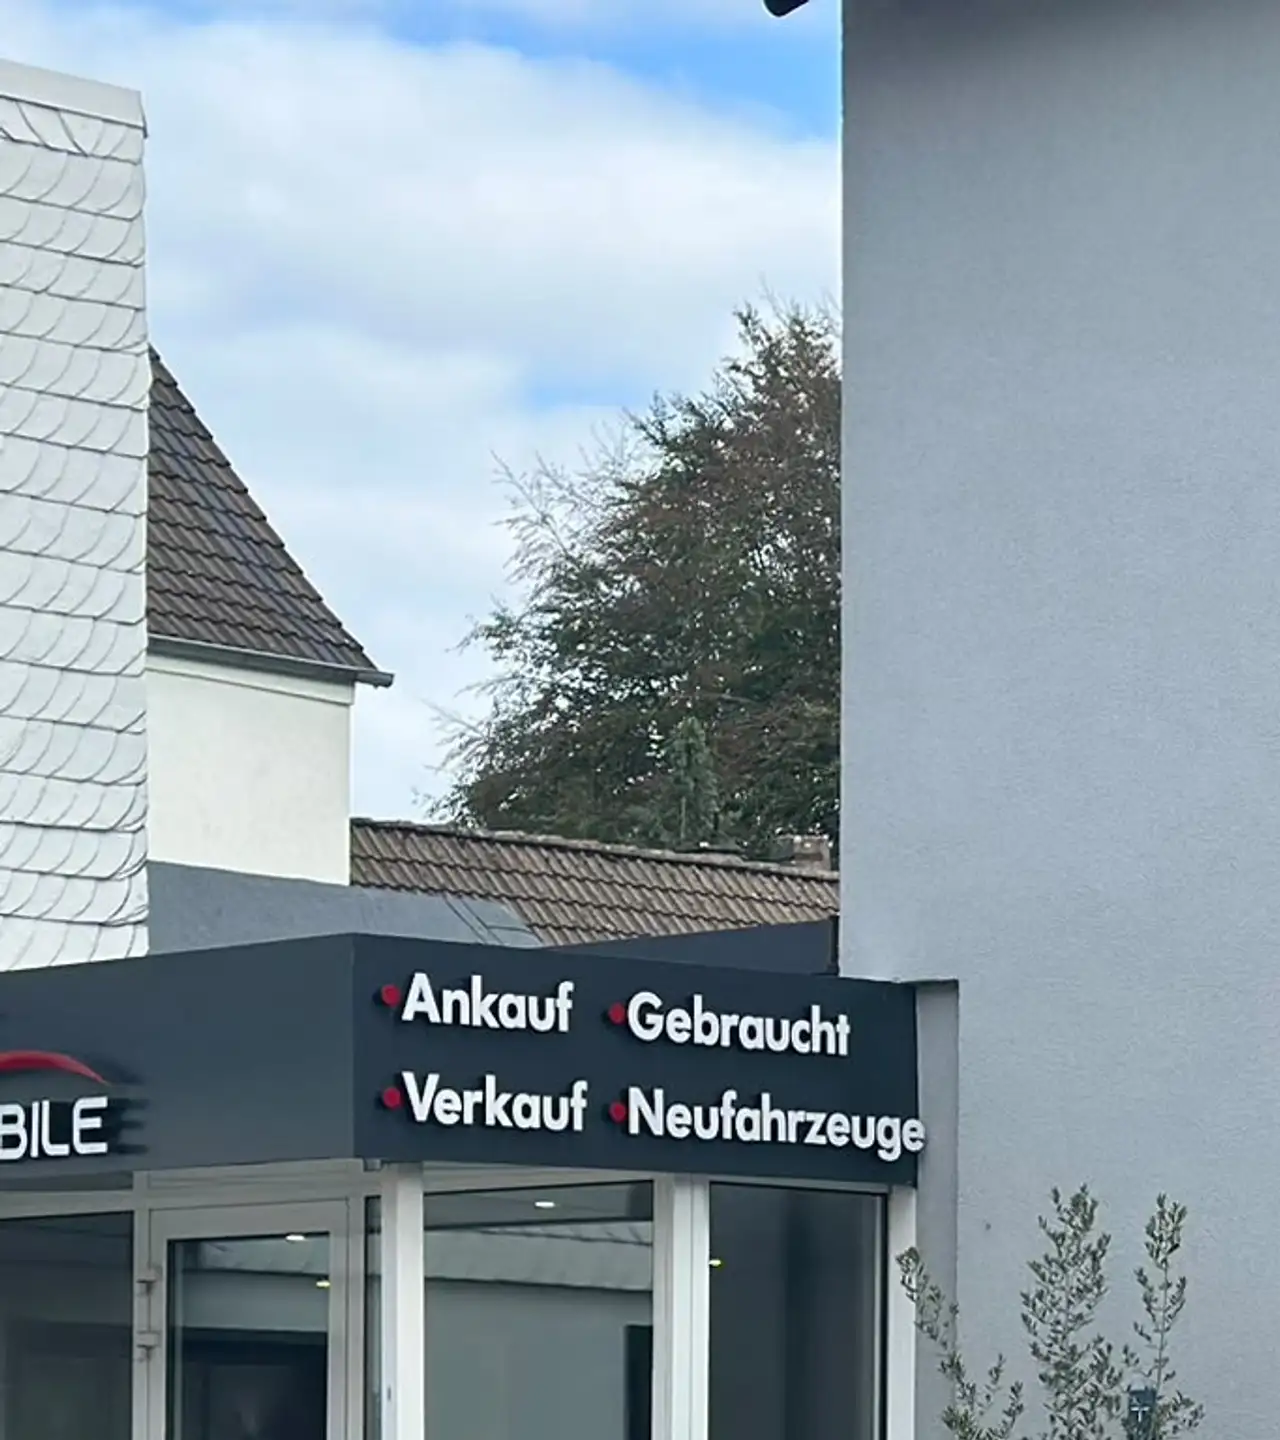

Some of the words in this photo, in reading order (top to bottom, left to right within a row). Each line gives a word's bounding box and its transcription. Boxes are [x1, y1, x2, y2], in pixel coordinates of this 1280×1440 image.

[401, 971, 575, 1033] Ankauf
[627, 990, 851, 1056] Gebraucht
[401, 1070, 589, 1133] Verkauf
[627, 1086, 926, 1162] Neufahrzeuge
